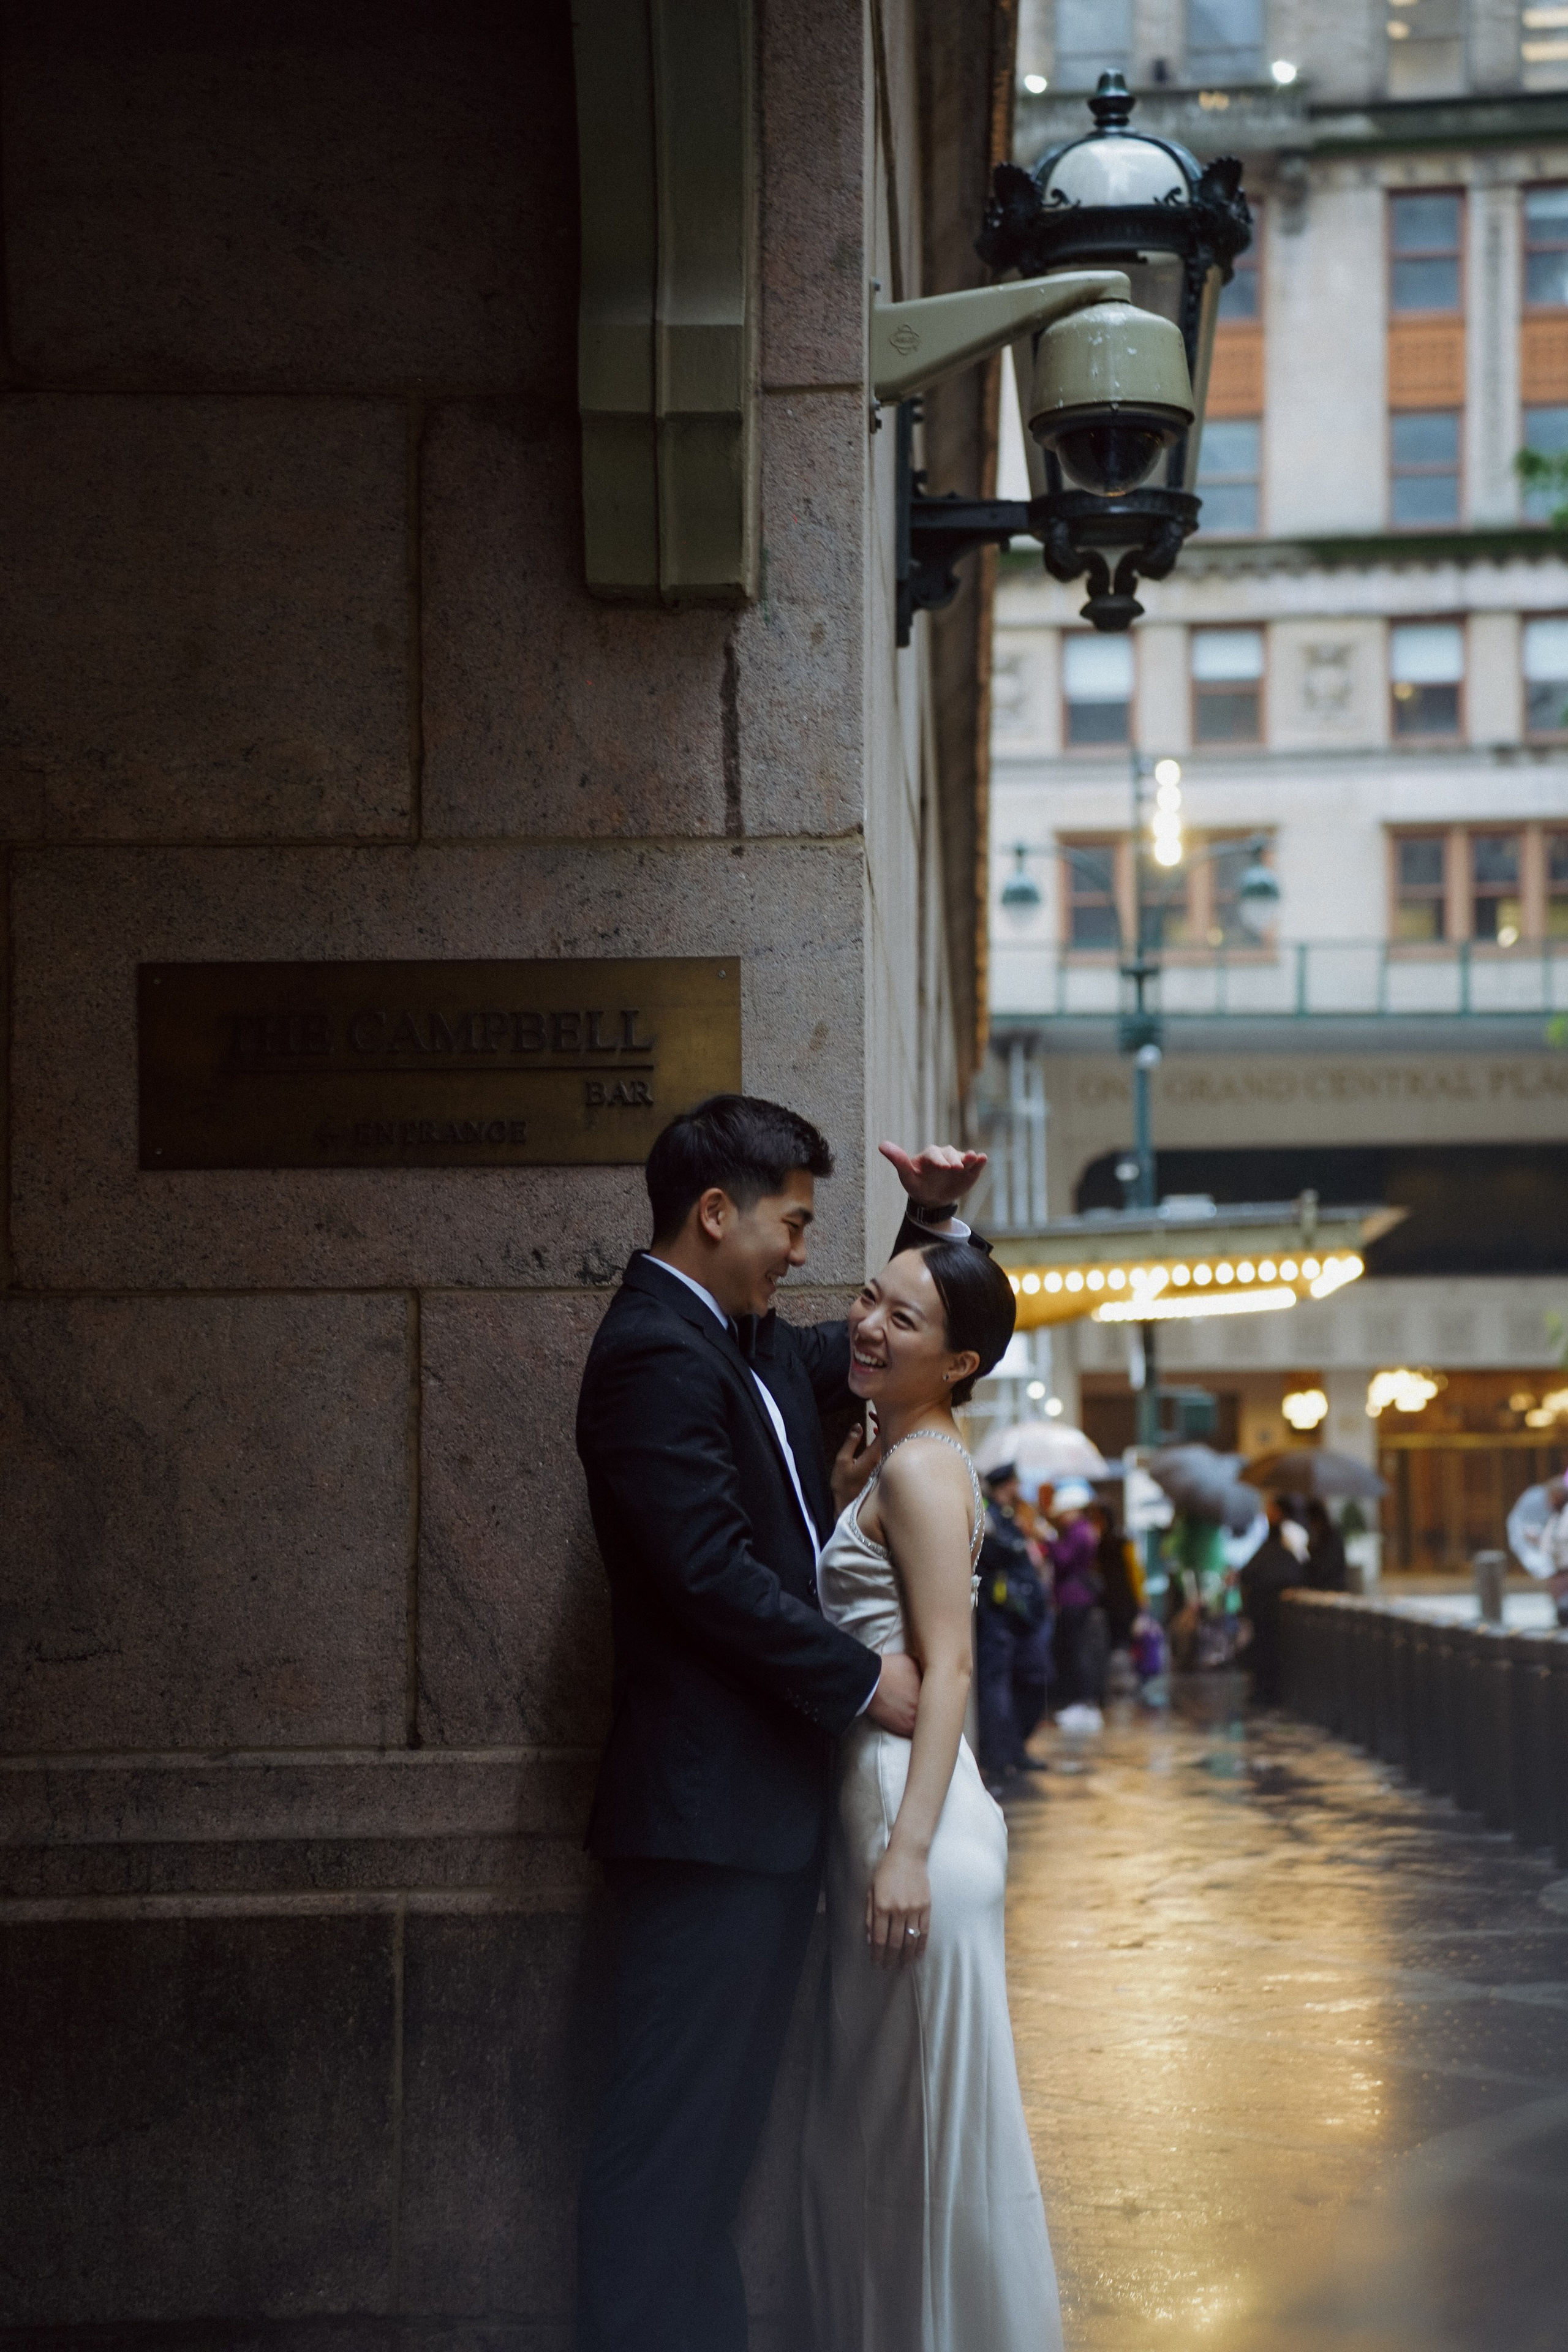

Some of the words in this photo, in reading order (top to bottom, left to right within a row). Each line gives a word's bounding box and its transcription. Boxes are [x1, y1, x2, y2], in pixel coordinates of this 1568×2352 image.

[219, 1011, 334, 1056] THE
[347, 1009, 655, 1054] CAMPBELL
[584, 1080, 654, 1108] BAR
[353, 1120, 527, 1146] ENTRANCE
